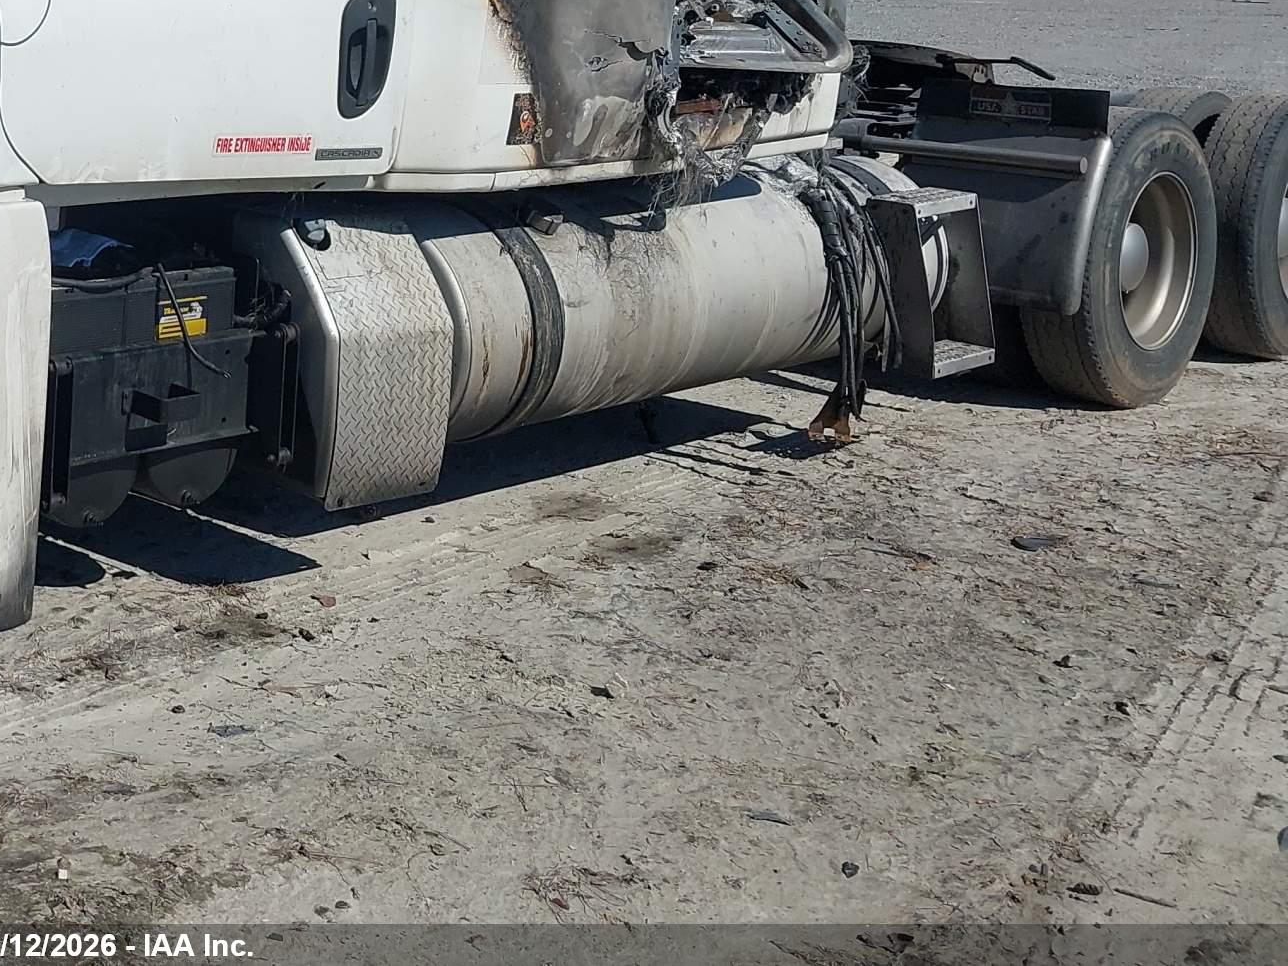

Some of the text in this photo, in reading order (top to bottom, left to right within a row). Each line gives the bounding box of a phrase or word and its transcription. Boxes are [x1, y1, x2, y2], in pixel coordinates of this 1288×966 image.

[215, 136, 312, 153] FIRE EXTINGUISHER INSIDE
